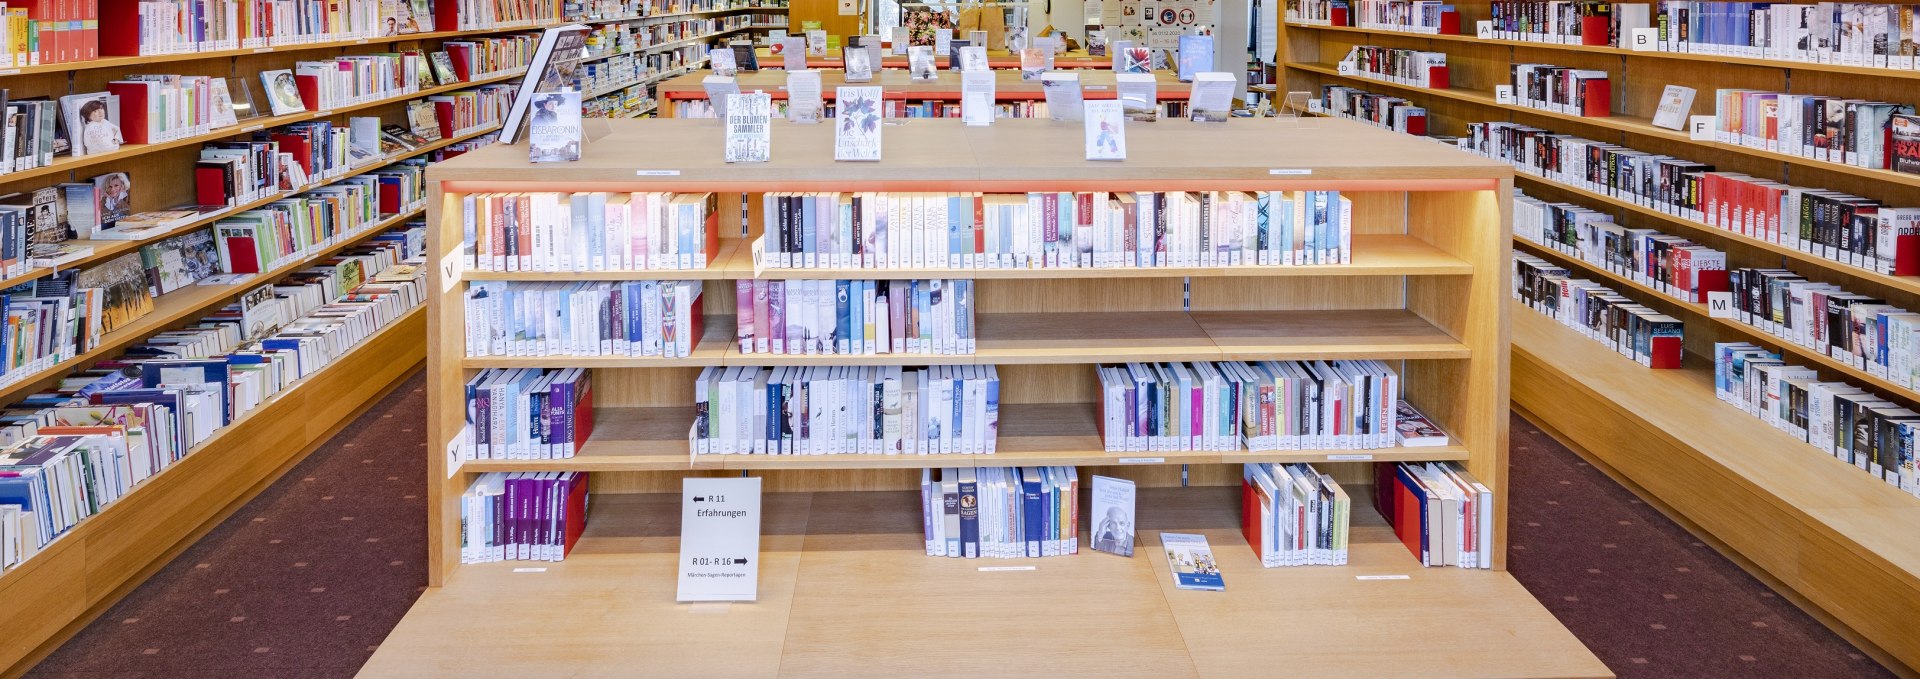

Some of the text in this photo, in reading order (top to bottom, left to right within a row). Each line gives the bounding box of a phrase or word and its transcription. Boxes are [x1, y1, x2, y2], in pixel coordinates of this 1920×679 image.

[1481, 26, 1489, 34] A
[1637, 34, 1647, 45] B
[840, 88, 879, 98] Iris Wolff
[1500, 90, 1508, 99] E
[730, 116, 742, 124] DER
[532, 125, 579, 135] EISBARONIN
[734, 125, 764, 133] SAMMLER
[1696, 123, 1704, 134] F
[1802, 197, 1810, 219] ARGUS
[754, 250, 762, 266] W
[445, 261, 453, 278] V
[1712, 299, 1726, 311] M
[452, 445, 460, 462] Y
[697, 509, 747, 519] Erfahrungen
